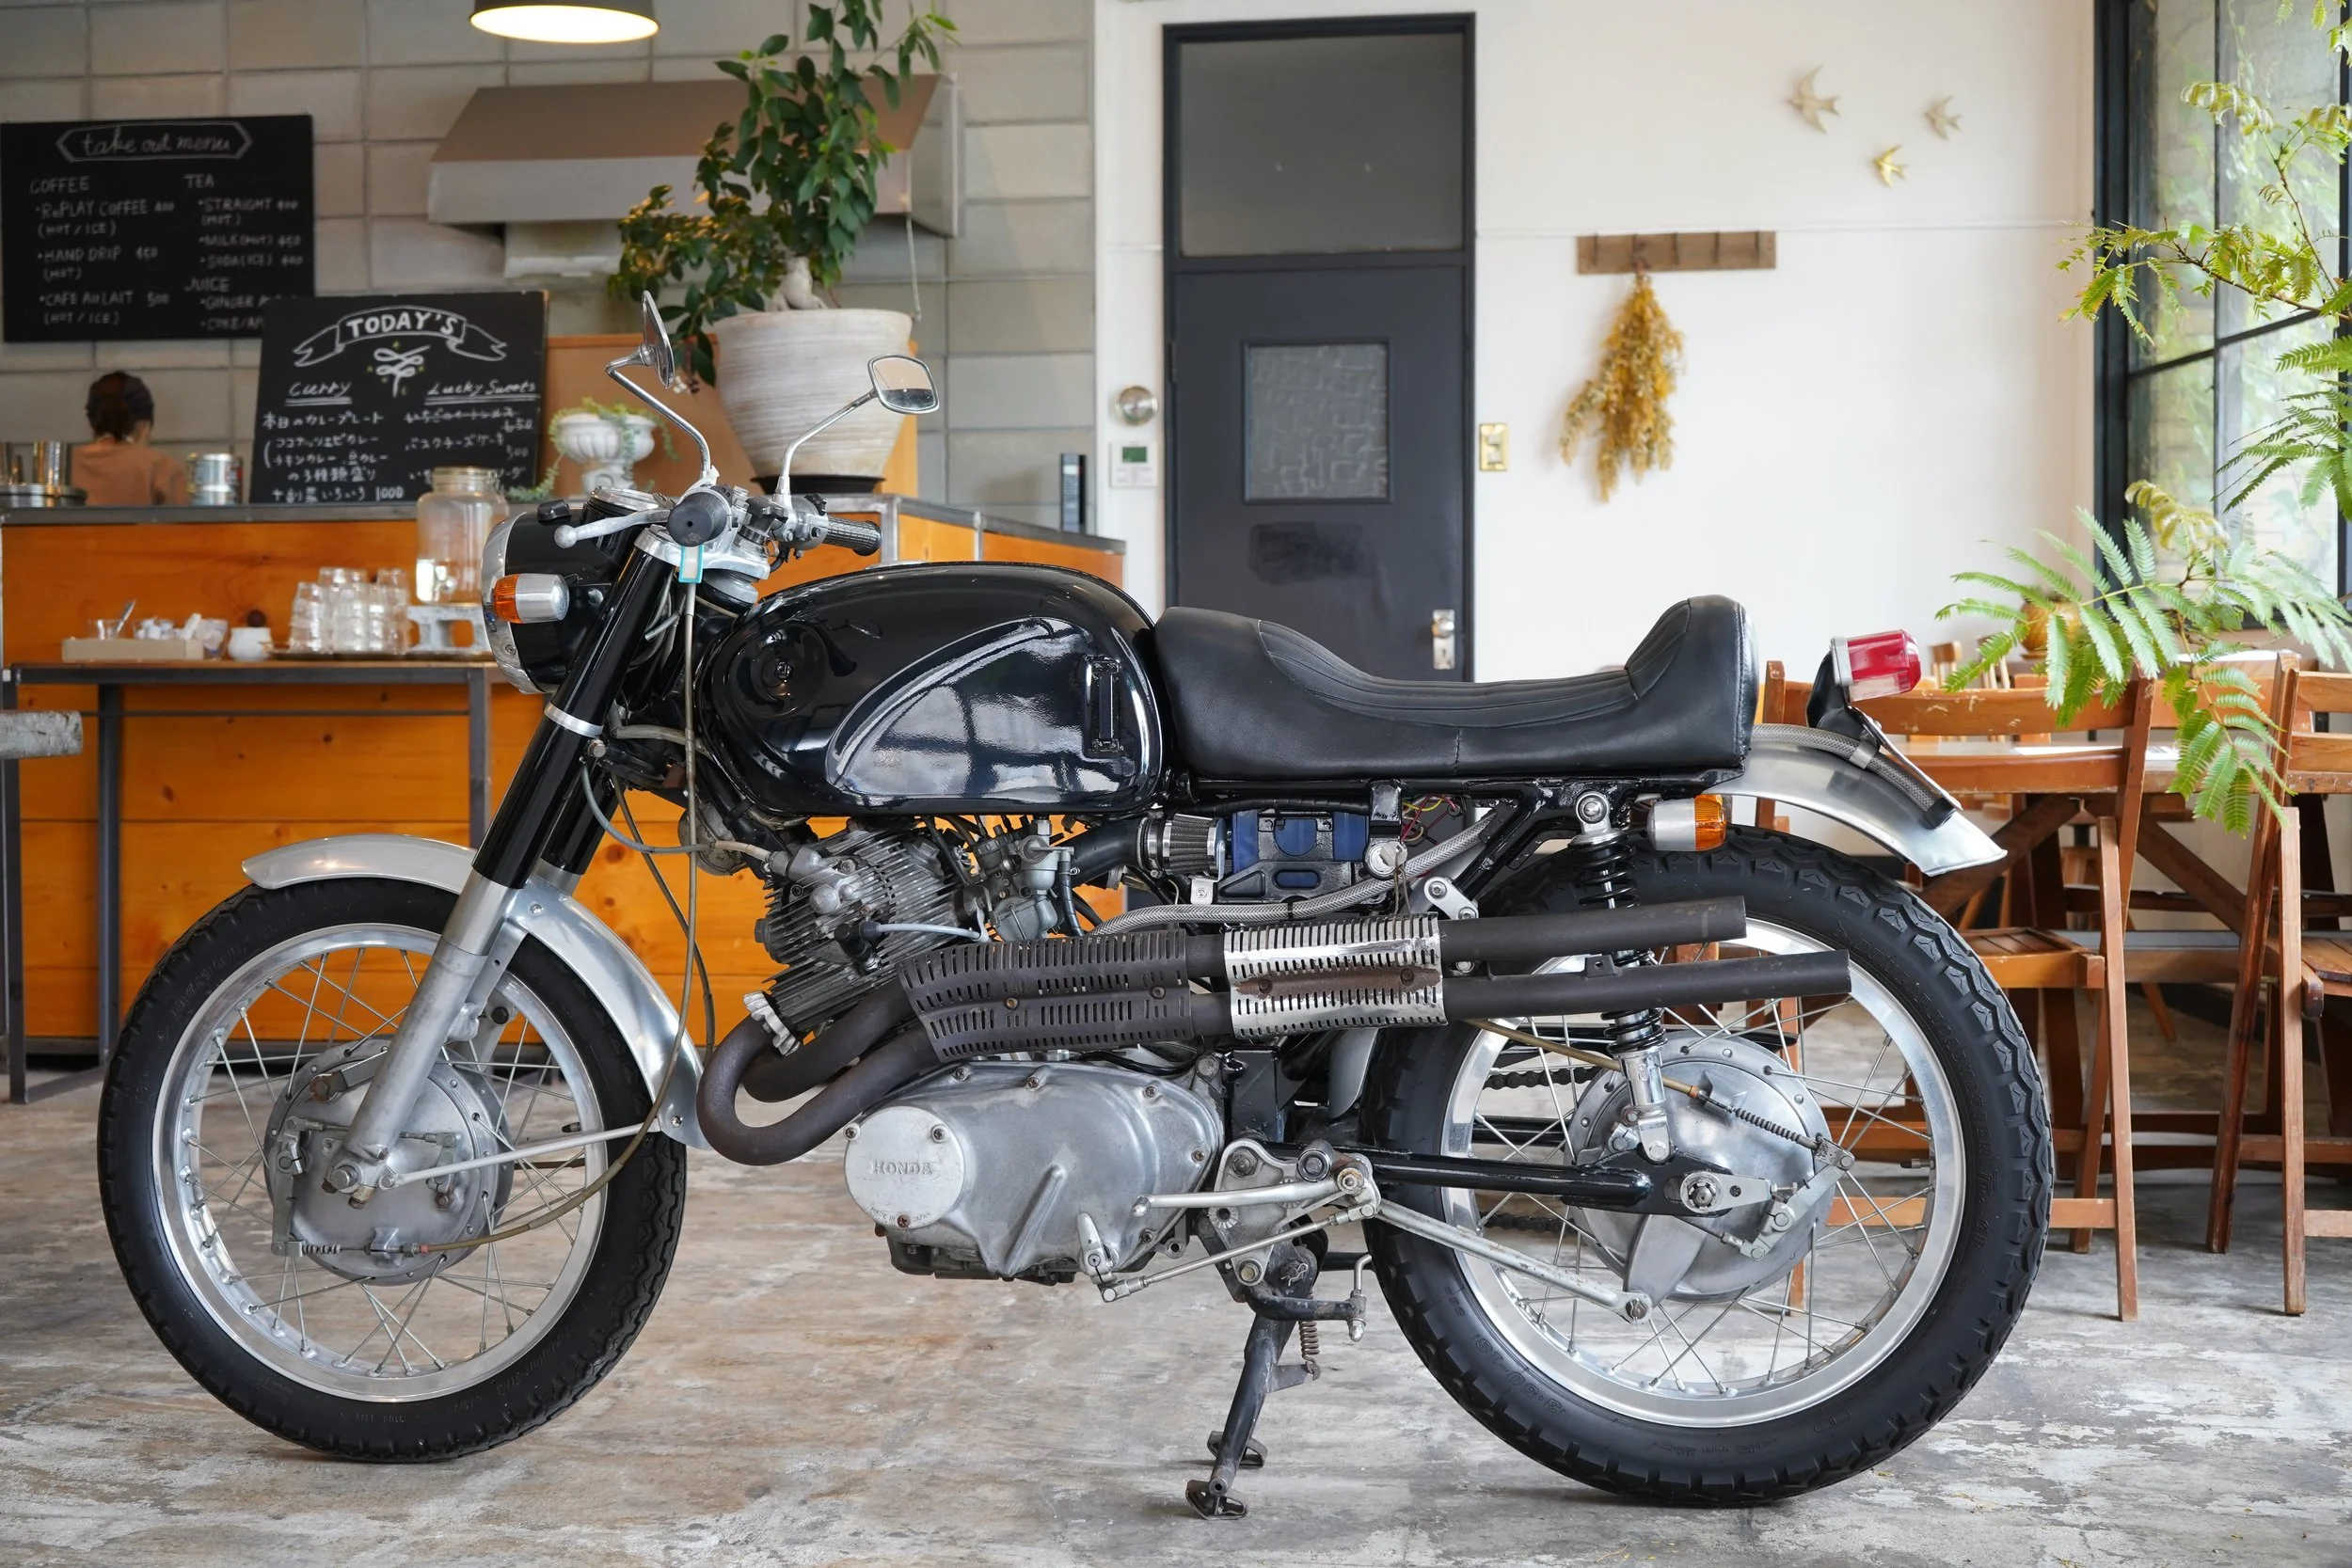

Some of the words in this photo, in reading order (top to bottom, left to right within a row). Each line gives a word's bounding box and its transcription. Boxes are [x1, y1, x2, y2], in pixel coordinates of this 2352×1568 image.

[82, 124, 137, 156] take
[142, 133, 173, 152] out
[177, 136, 230, 151] menu
[29, 175, 91, 195] COFFEE
[183, 173, 215, 188] TEA
[99, 198, 149, 217] COFFEE
[44, 246, 86, 263] HAND
[87, 244, 122, 262] DRIP
[183, 276, 230, 293] JUICE
[346, 311, 458, 339] TODAY'S
[289, 381, 352, 399] Curry
[427, 382, 484, 397] Lucky
[485, 379, 537, 396] Sweets
[262, 410, 384, 430] 本日のカレープレート
[375, 485, 405, 502] 1000
[870, 1161, 932, 1175] HONDA
[870, 1206, 888, 1219] MADE
[912, 1212, 931, 1223] JAPAN
